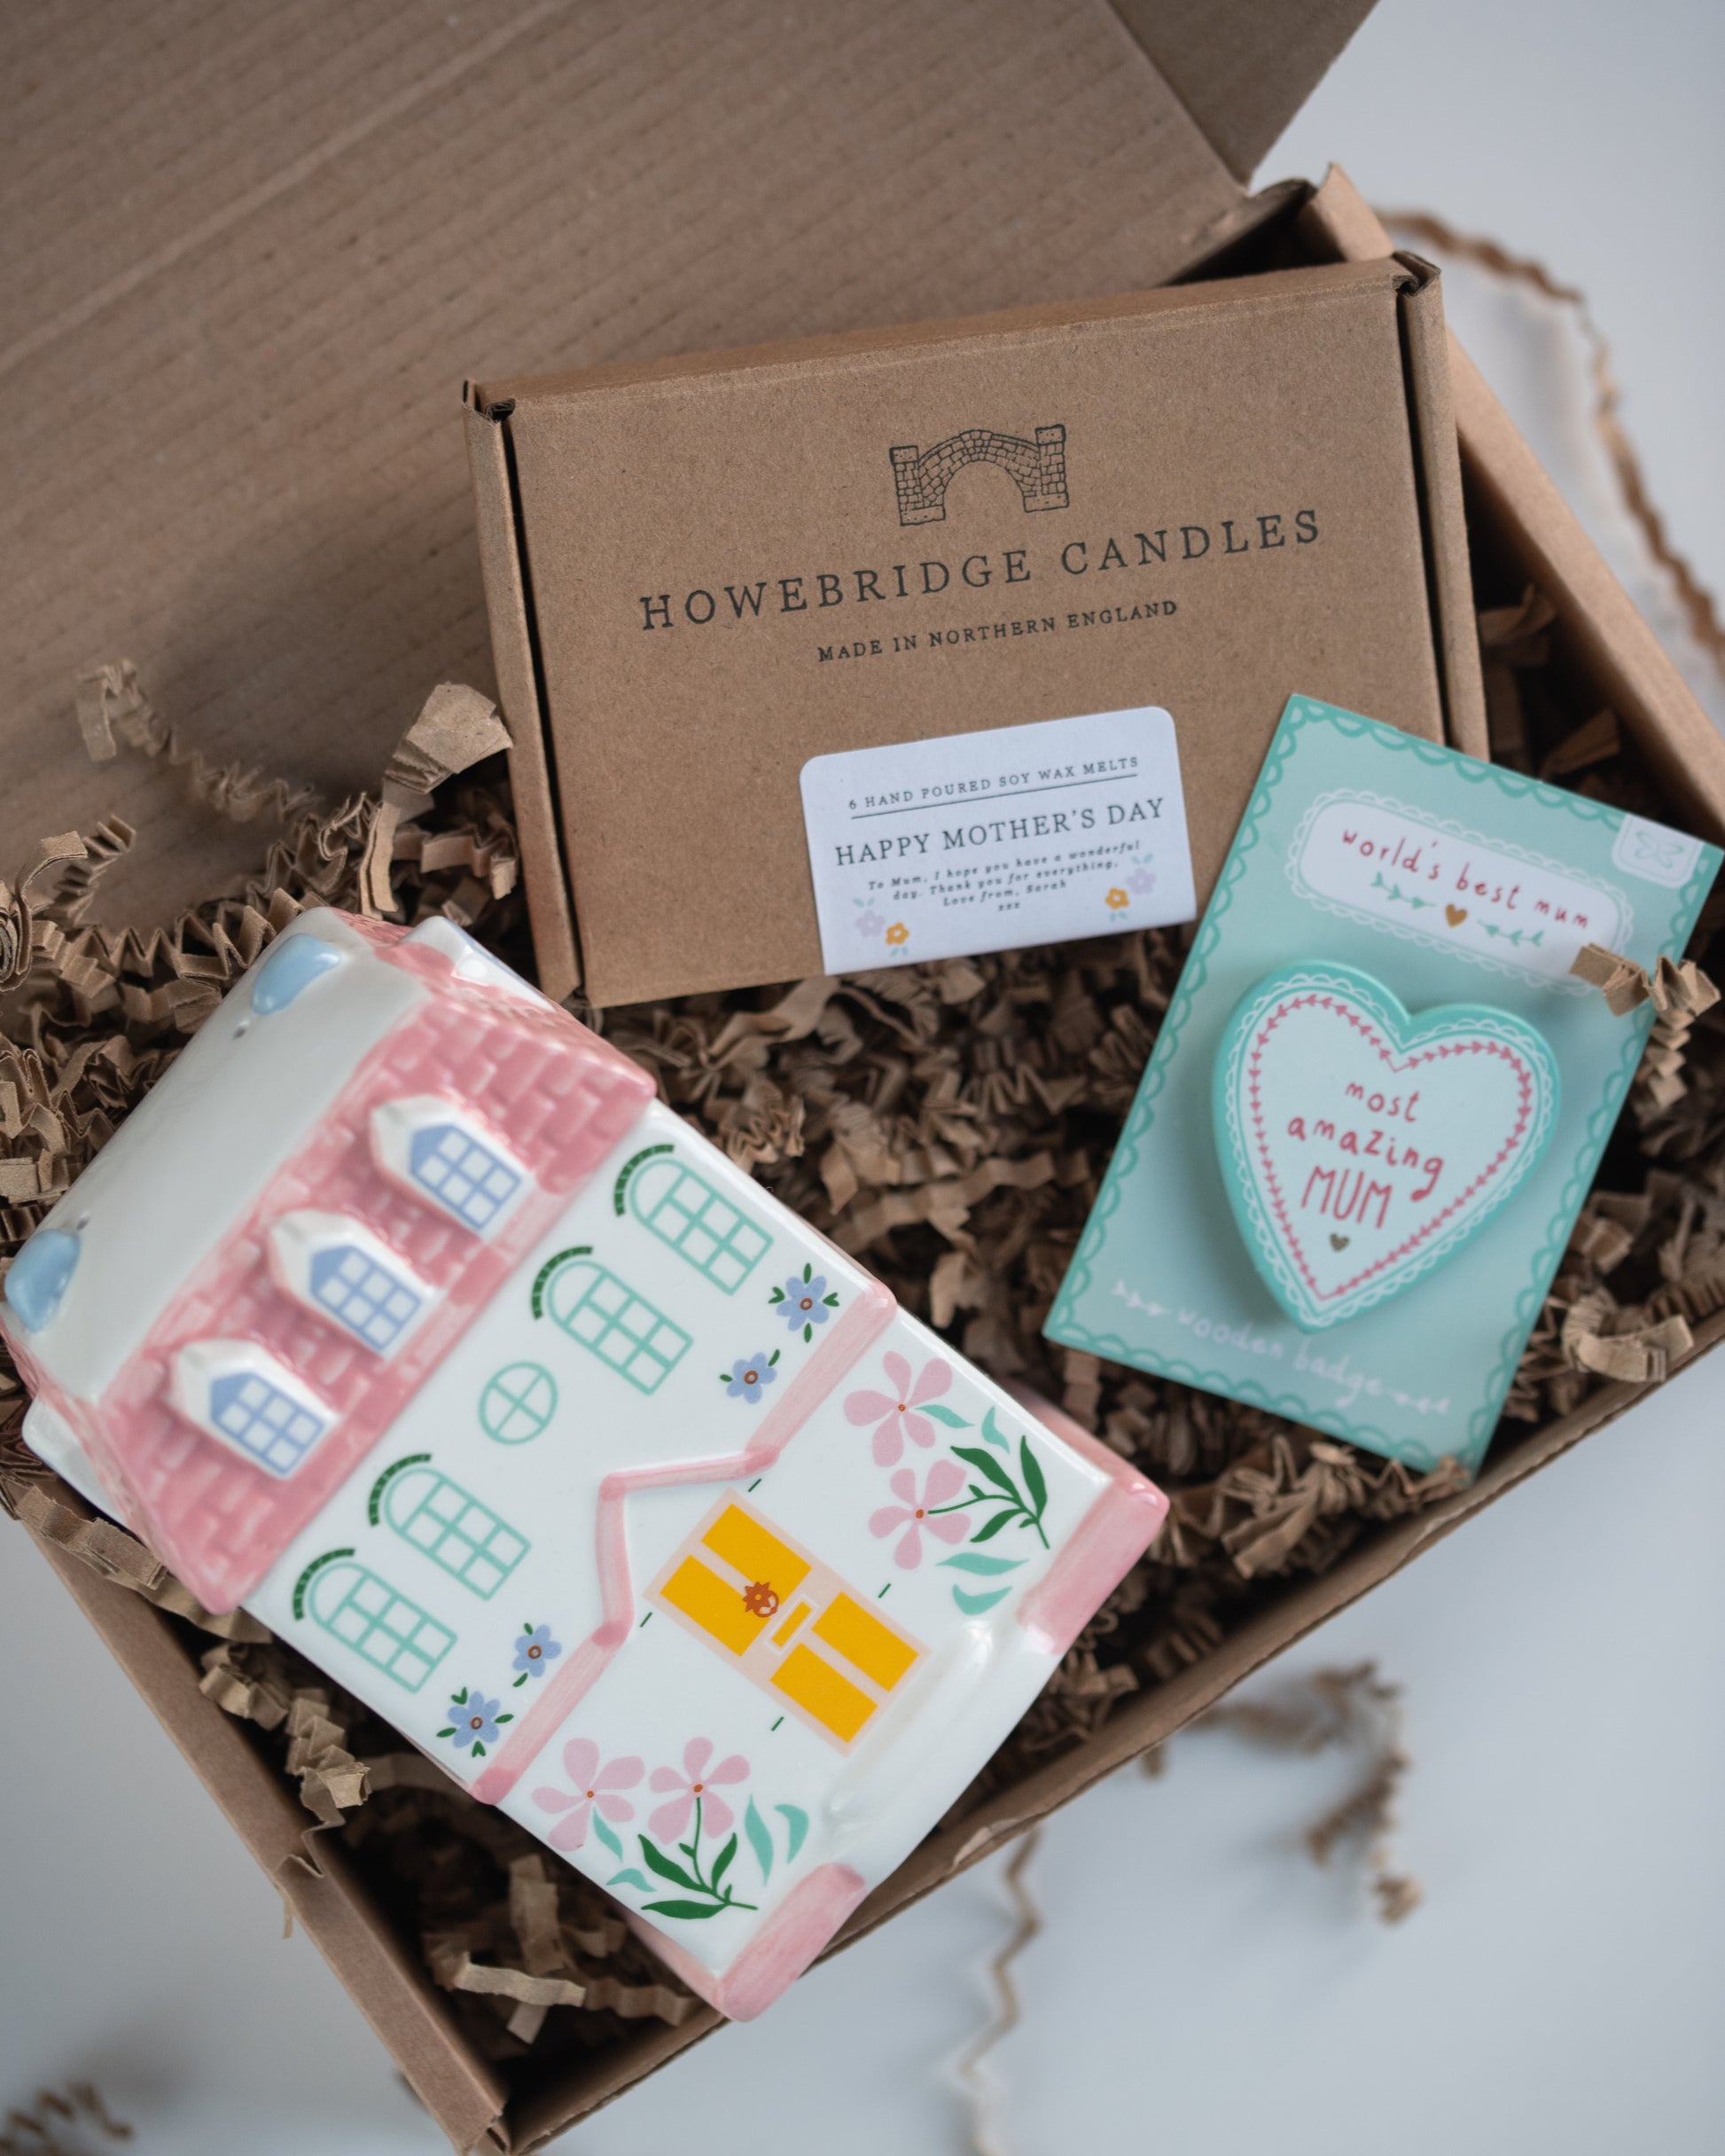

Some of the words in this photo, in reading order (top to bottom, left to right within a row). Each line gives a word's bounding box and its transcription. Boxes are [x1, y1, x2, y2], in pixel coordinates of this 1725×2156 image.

[640, 550, 1031, 630] HOWEBRIDGE
[1060, 510, 1320, 576] CANDLES
[817, 638, 884, 662] MADE
[893, 631, 917, 653] IN
[928, 614, 1056, 648] NORTHERN
[1067, 599, 1178, 629] ENGLAND
[848, 800, 858, 810] 6
[864, 791, 914, 808] HAND
[922, 778, 992, 800] POURED
[999, 772, 1031, 787] SOY
[1038, 766, 1075, 781] WAX
[1083, 757, 1139, 775] MELTS
[835, 833, 931, 866] HAPPY
[941, 808, 1096, 851] MOTHER'S
[1108, 798, 1164, 825] DAY
[868, 880, 884, 891] To
[947, 867, 978, 878] hope
[985, 863, 1010, 874] you
[1016, 856, 1048, 867] have
[1069, 840, 1140, 860] wonderful
[930, 879, 971, 895] Thank
[978, 877, 1003, 889] you
[1007, 873, 1029, 885] for
[943, 894, 975, 907] Love
[1026, 879, 1066, 894] Sarah
[1342, 829, 1441, 881] world's
[1456, 863, 1520, 910] best
[1534, 897, 1588, 928] mum
[1345, 1081, 1419, 1122] most
[1287, 1116, 1444, 1203] amazing
[1300, 1164, 1393, 1230] MUM
[1177, 1308, 1284, 1359] wooden
[1293, 1336, 1383, 1409] badge
